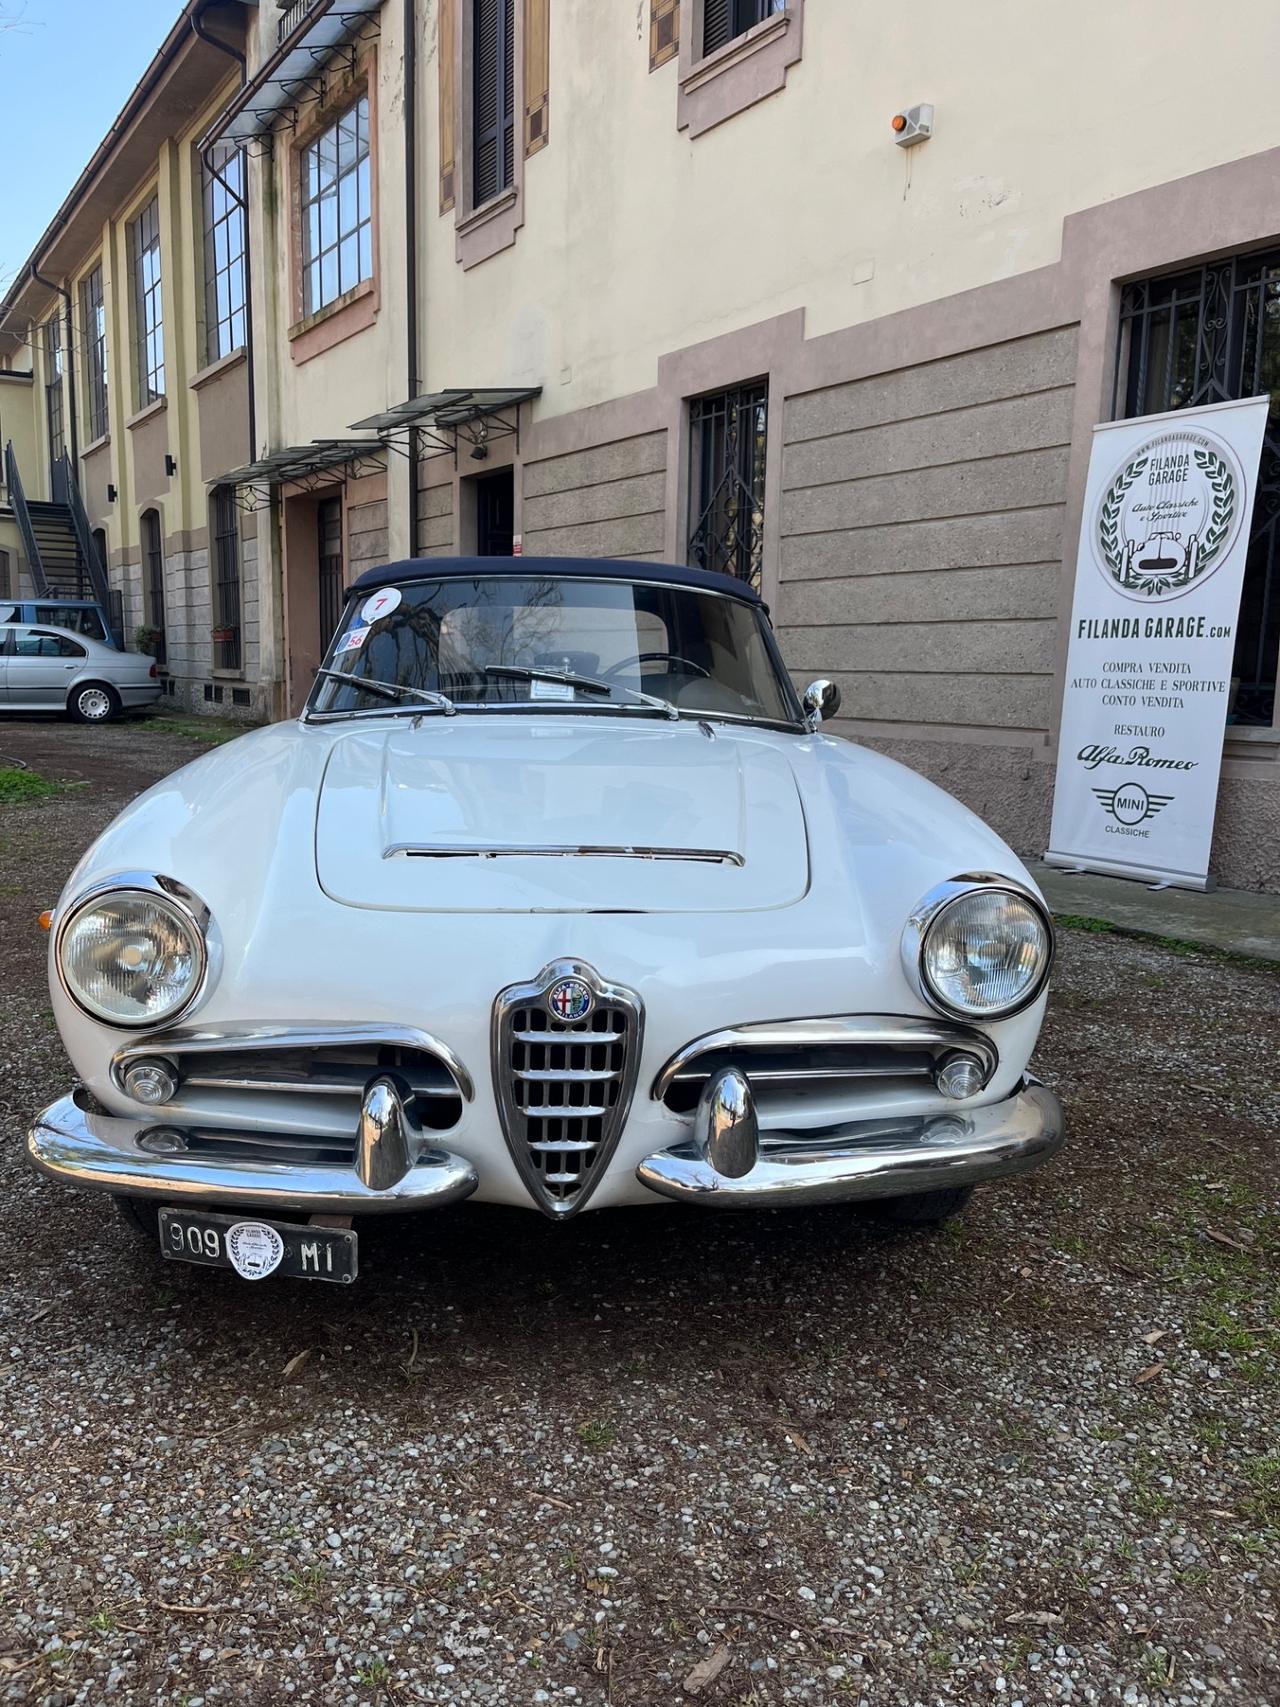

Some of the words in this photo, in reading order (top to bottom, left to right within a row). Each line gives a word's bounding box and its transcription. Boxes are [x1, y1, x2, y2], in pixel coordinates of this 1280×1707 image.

[1150, 454, 1190, 471] FILANDA
[1148, 467, 1189, 486] GARAGE
[1155, 497, 1199, 511] Classiche
[1146, 510, 1188, 523] Sportive
[375, 598, 388, 611] 7
[1078, 618, 1140, 639] FILANDA
[348, 635, 362, 647] 56
[1102, 661, 1143, 673] COMPRA
[1149, 662, 1192, 674] VENDITA
[1071, 678, 1097, 689] AUTO
[1101, 678, 1156, 691] CLASSICHE
[1160, 680, 1167, 690] E
[1172, 680, 1226, 693] SPORTIVE
[1102, 694, 1136, 706] CONTO
[1141, 695, 1184, 708] VENDITA
[1114, 724, 1165, 737] RESTAURO
[1077, 744, 1124, 770] Alfa
[1124, 746, 1199, 771] Romeo
[1117, 797, 1144, 811] MINI
[1105, 825, 1150, 838] CLASSICHE
[301, 1241, 333, 1272] MI
